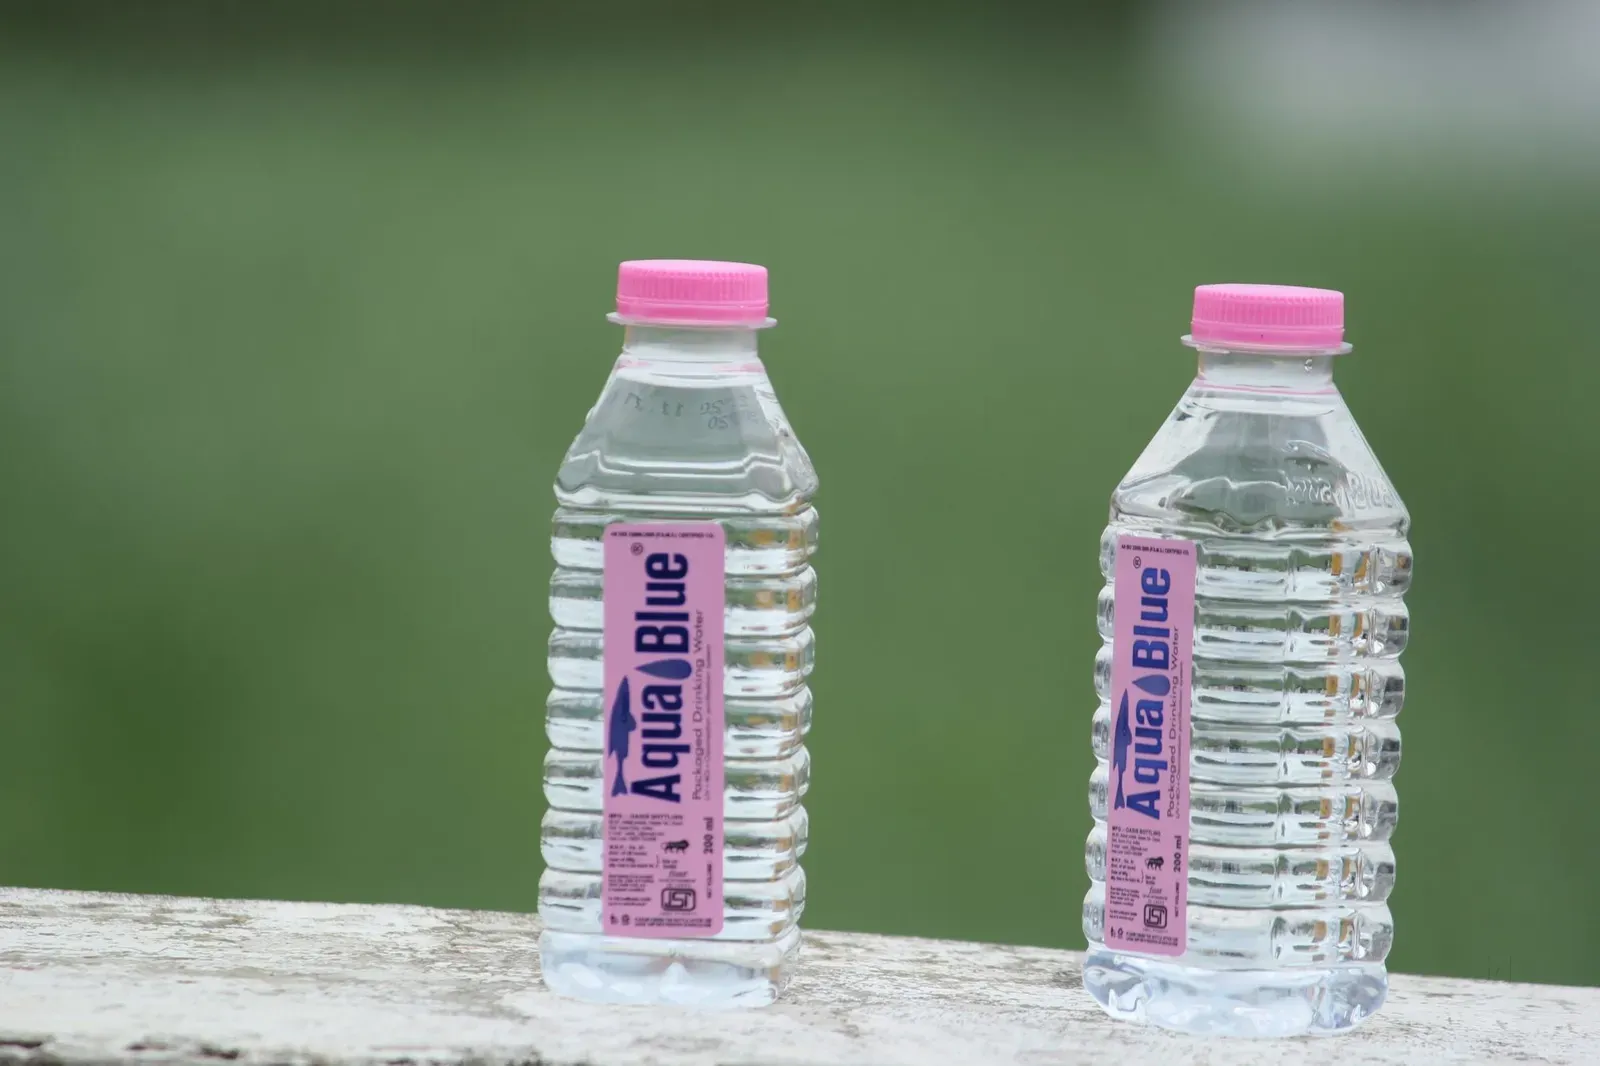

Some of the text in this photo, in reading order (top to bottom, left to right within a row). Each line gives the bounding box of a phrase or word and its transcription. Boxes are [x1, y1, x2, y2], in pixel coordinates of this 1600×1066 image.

[634, 552, 689, 654] Blue
[1132, 566, 1171, 671] Blue
[631, 684, 691, 804] Aqua
[692, 610, 705, 801] Packaged Drinking Water
[1167, 626, 1179, 818] Packaged Drinking Water
[1126, 698, 1167, 820] Aqua
[703, 816, 714, 831] ml
[703, 834, 714, 855] 200
[1173, 835, 1182, 873] 200 ml
